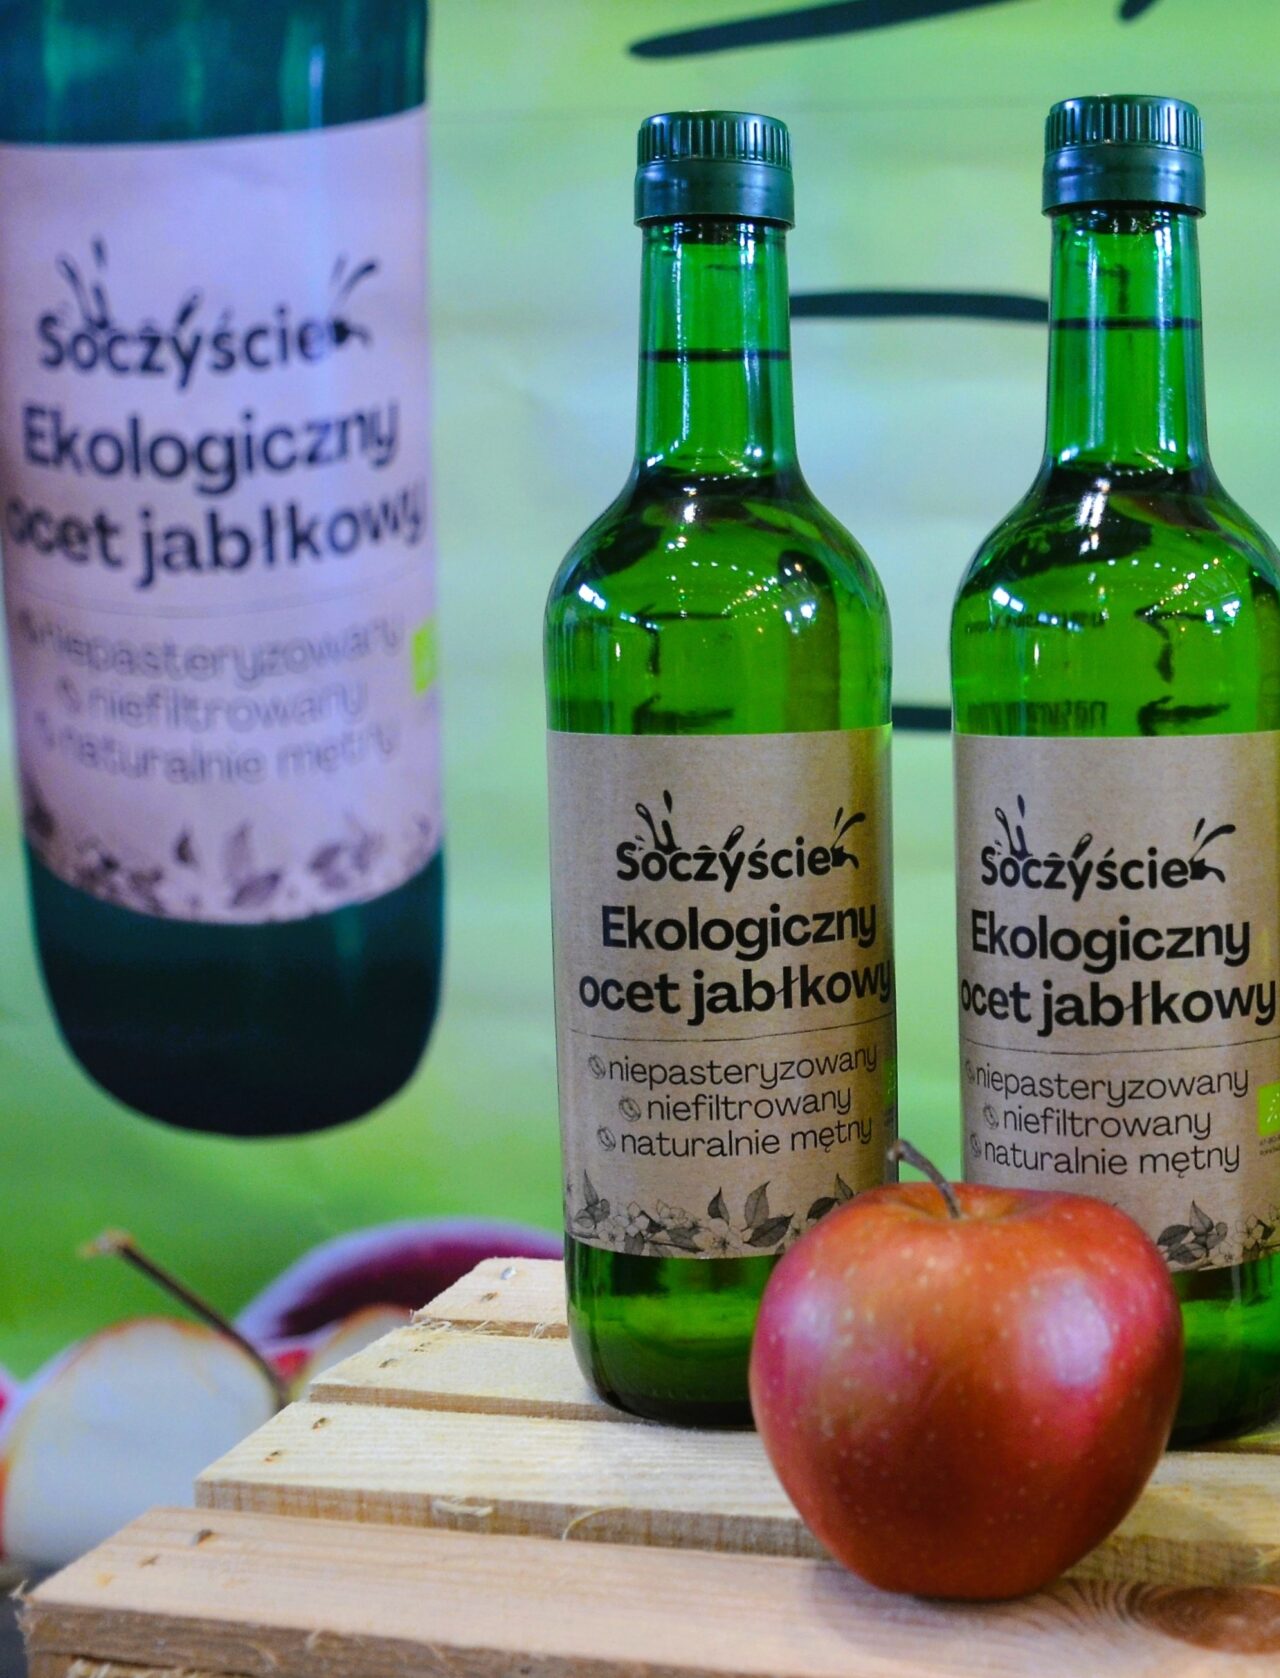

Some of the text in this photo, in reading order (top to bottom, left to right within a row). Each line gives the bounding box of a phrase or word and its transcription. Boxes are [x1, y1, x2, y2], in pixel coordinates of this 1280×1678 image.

[25, 402, 401, 494] Ekologiczny
[6, 505, 121, 568] ocet
[616, 825, 833, 892] Soczyście
[981, 834, 1191, 901] Soczyście
[601, 903, 876, 961] Ekologiczny
[972, 909, 1250, 973] Ekologiczny
[579, 958, 892, 1026] ocet jabłkowy
[961, 978, 1277, 1038] ocet jabłkowy
[609, 1043, 878, 1090] niepasteryzowany
[976, 1064, 1249, 1108] niepasteryzowany
[647, 1085, 851, 1121] niefiltrowany
[1003, 1105, 1211, 1140] niefiltrowany
[620, 1114, 873, 1158] naturalnie mętny
[984, 1138, 1127, 1175] naturalnie
[1139, 1142, 1240, 1178] mętny
